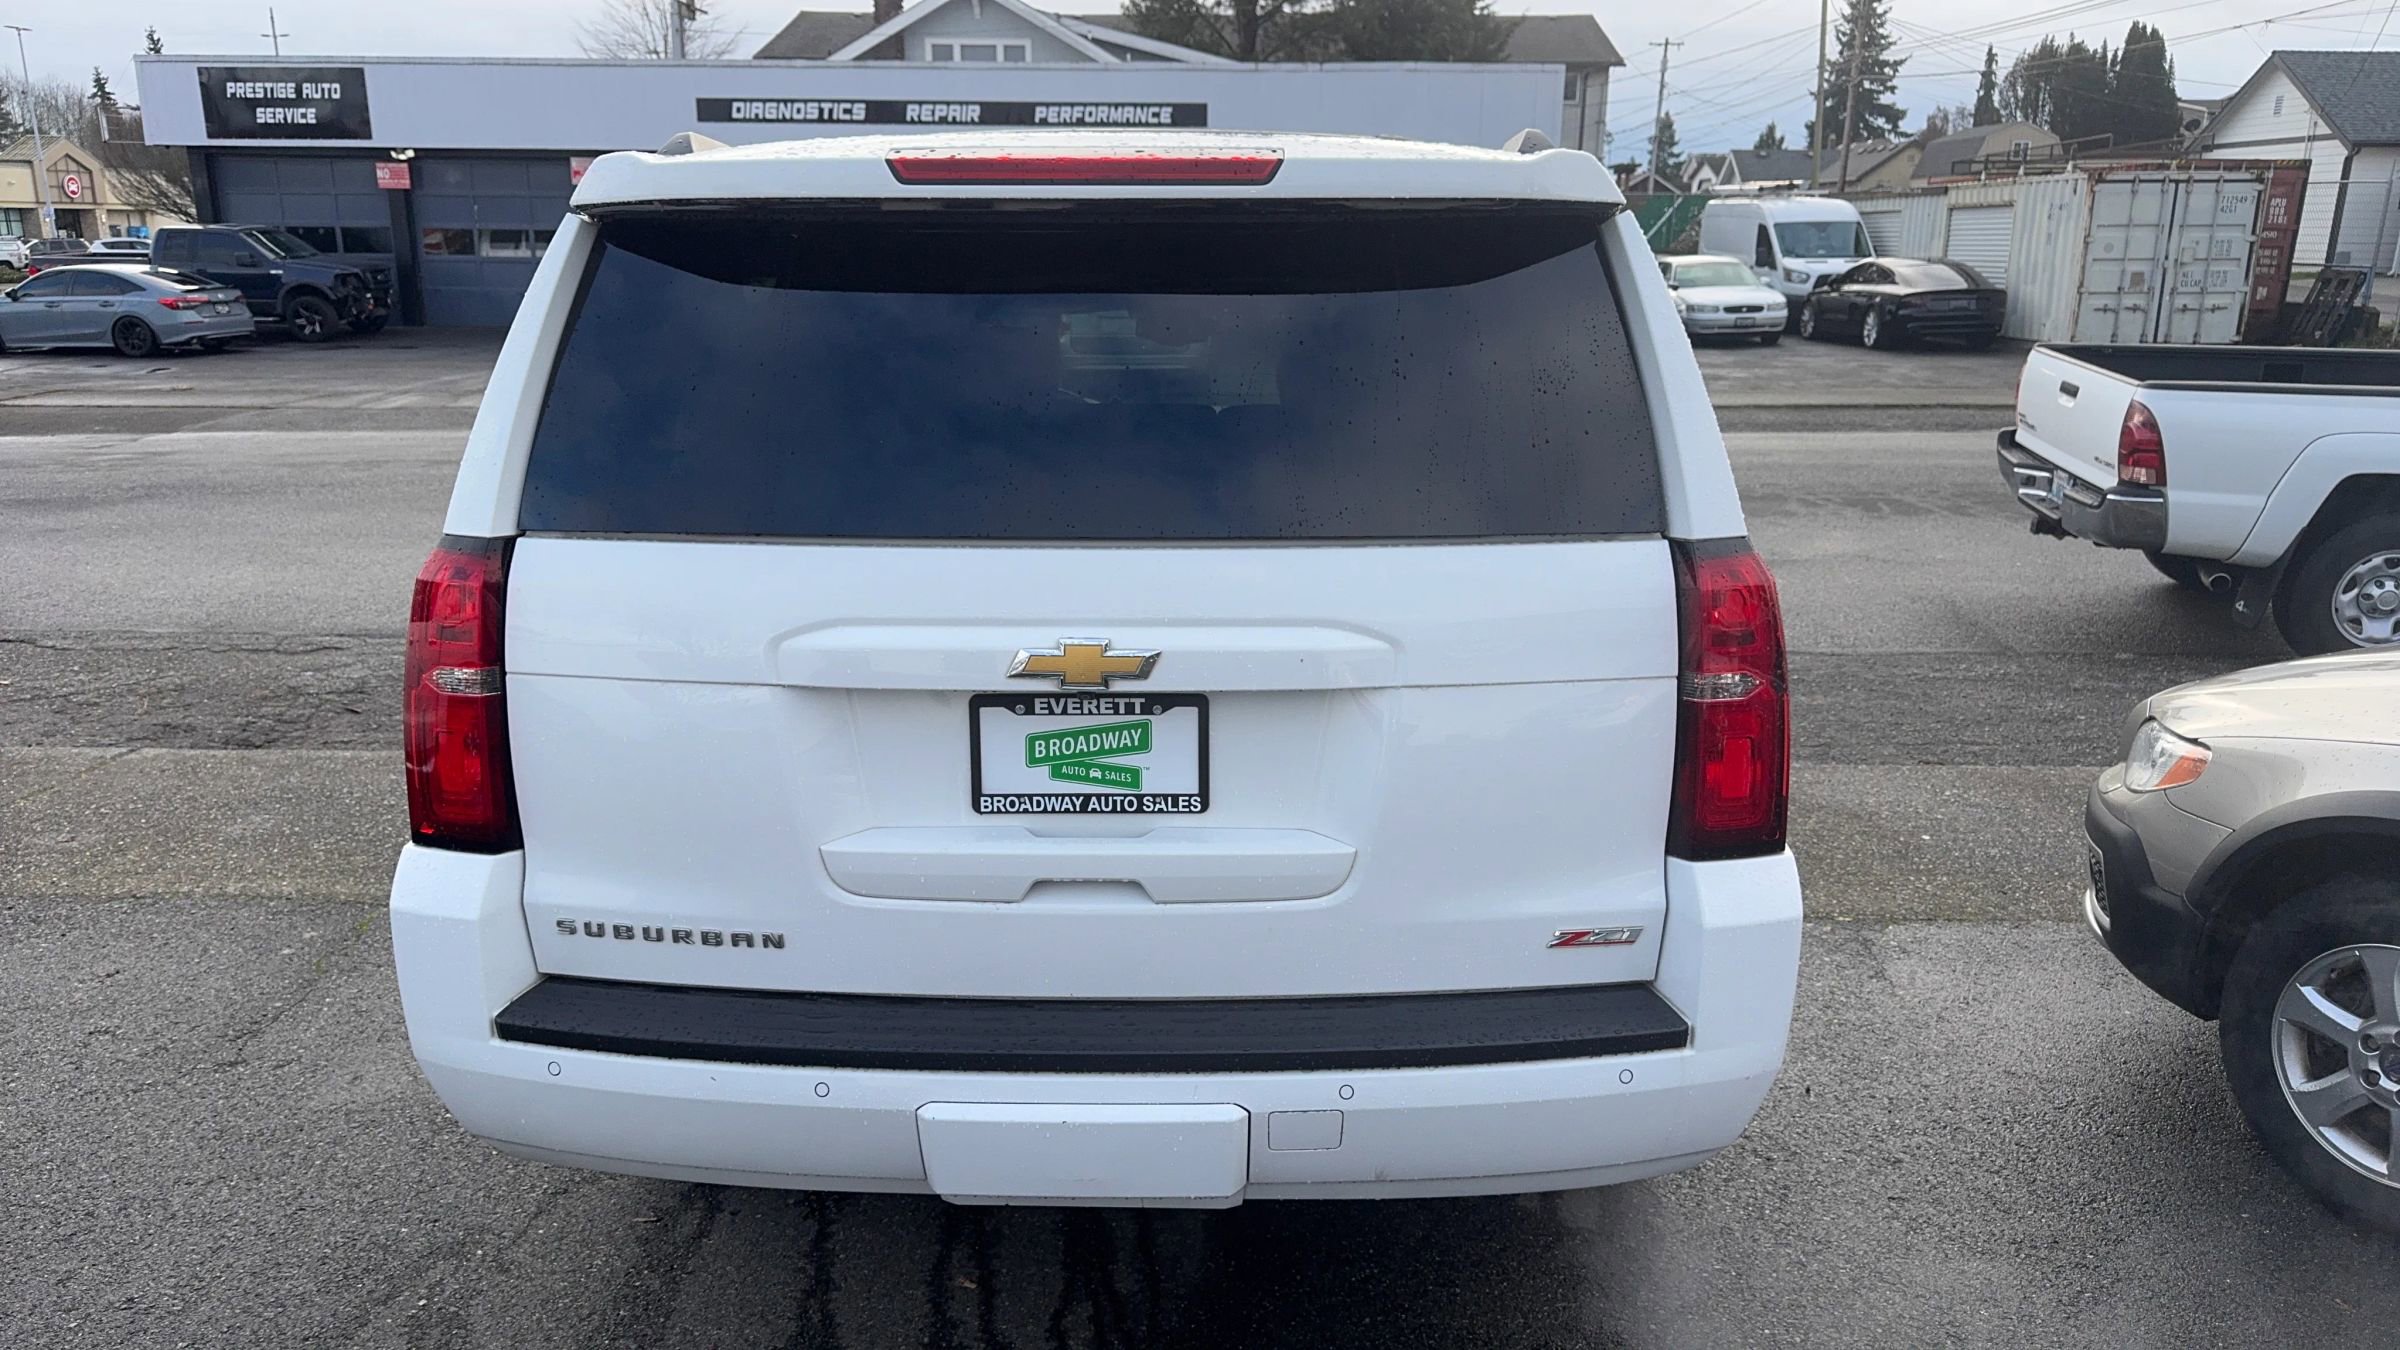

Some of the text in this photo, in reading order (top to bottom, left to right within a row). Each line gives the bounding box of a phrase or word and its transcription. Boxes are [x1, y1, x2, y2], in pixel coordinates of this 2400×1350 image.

[226, 82, 341, 99] PRESTIGE AUTO
[255, 107, 317, 124] SERVICE
[731, 101, 1173, 124] DIAGNOSTICS REPAIR PERFORMANCE
[376, 167, 391, 179] NO
[1034, 697, 1146, 715] EVERETT
[1034, 728, 1142, 758] BROADWAY
[1061, 765, 1132, 782] AUTO SALES
[980, 796, 1201, 813] BROADWAY AUTO SALES
[556, 917, 786, 949] SUBURBAN
